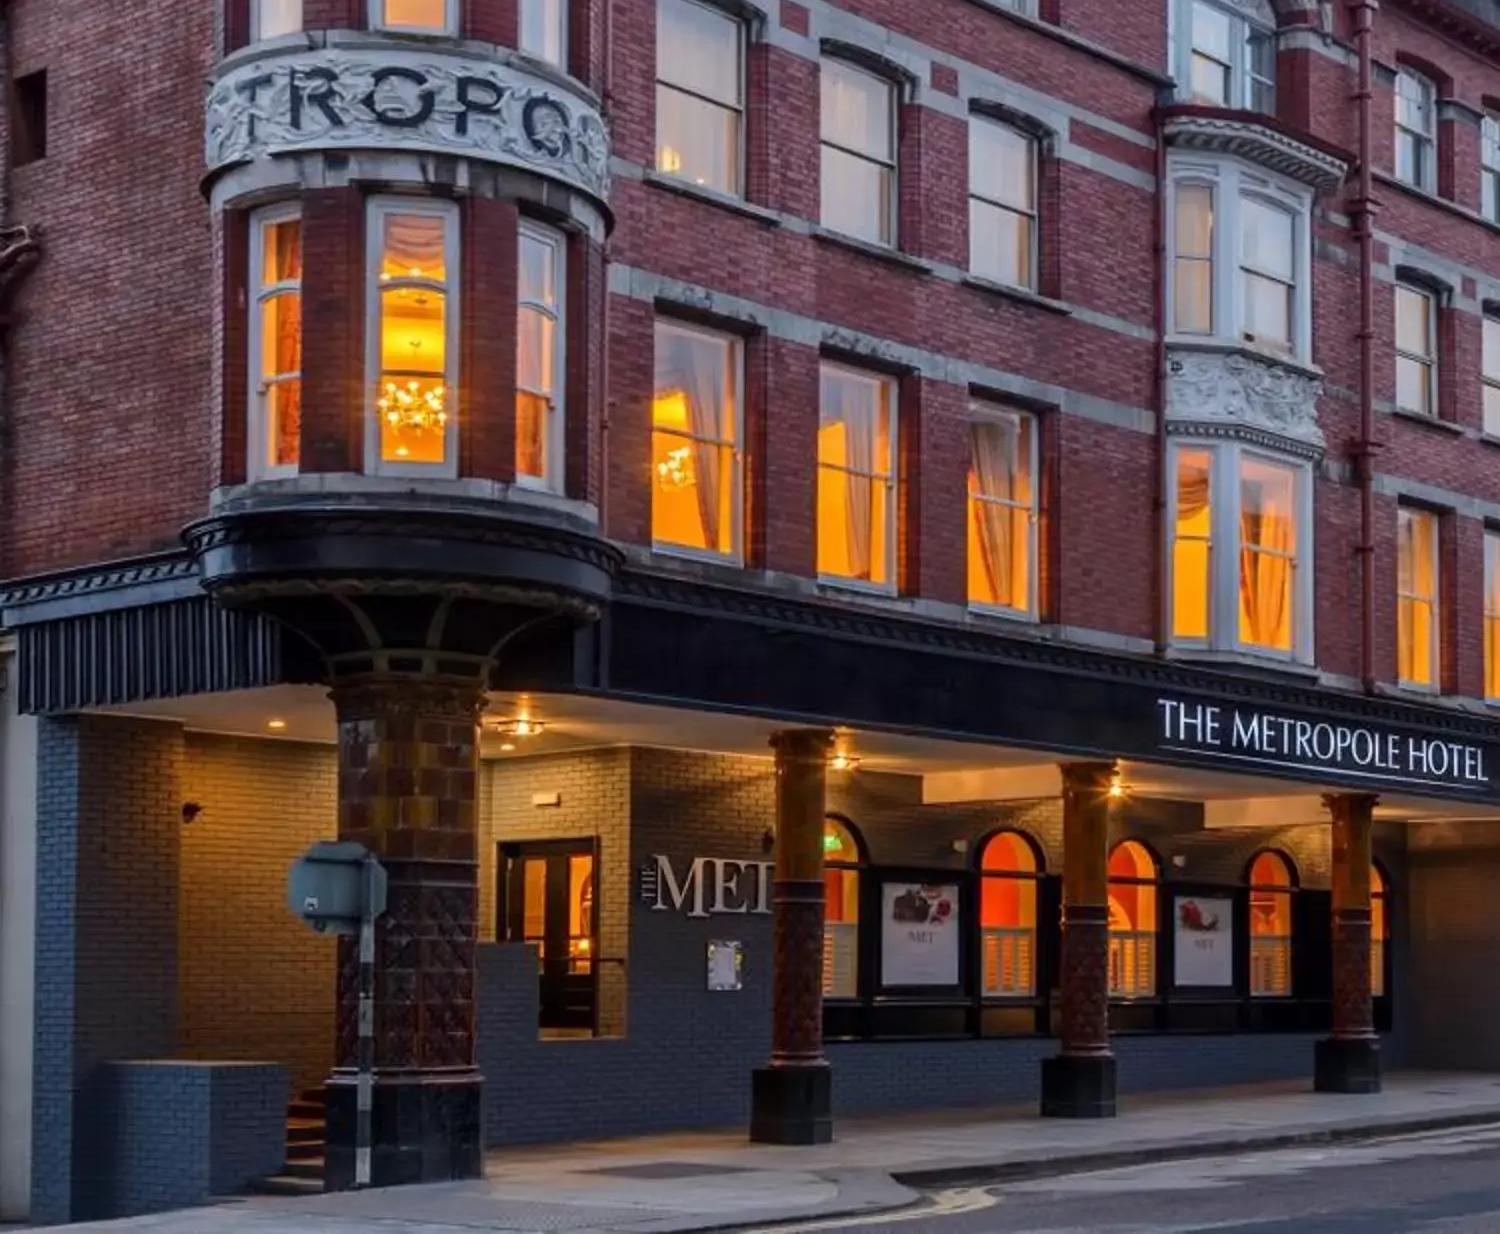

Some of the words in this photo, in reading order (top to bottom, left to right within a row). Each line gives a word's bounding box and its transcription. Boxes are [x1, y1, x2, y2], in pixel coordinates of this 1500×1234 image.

[1157, 699, 1221, 745] THE
[1231, 709, 1400, 769] METROPOLE
[1408, 737, 1490, 781] HOTEL
[641, 864, 656, 904] THE
[652, 854, 776, 917] MET
